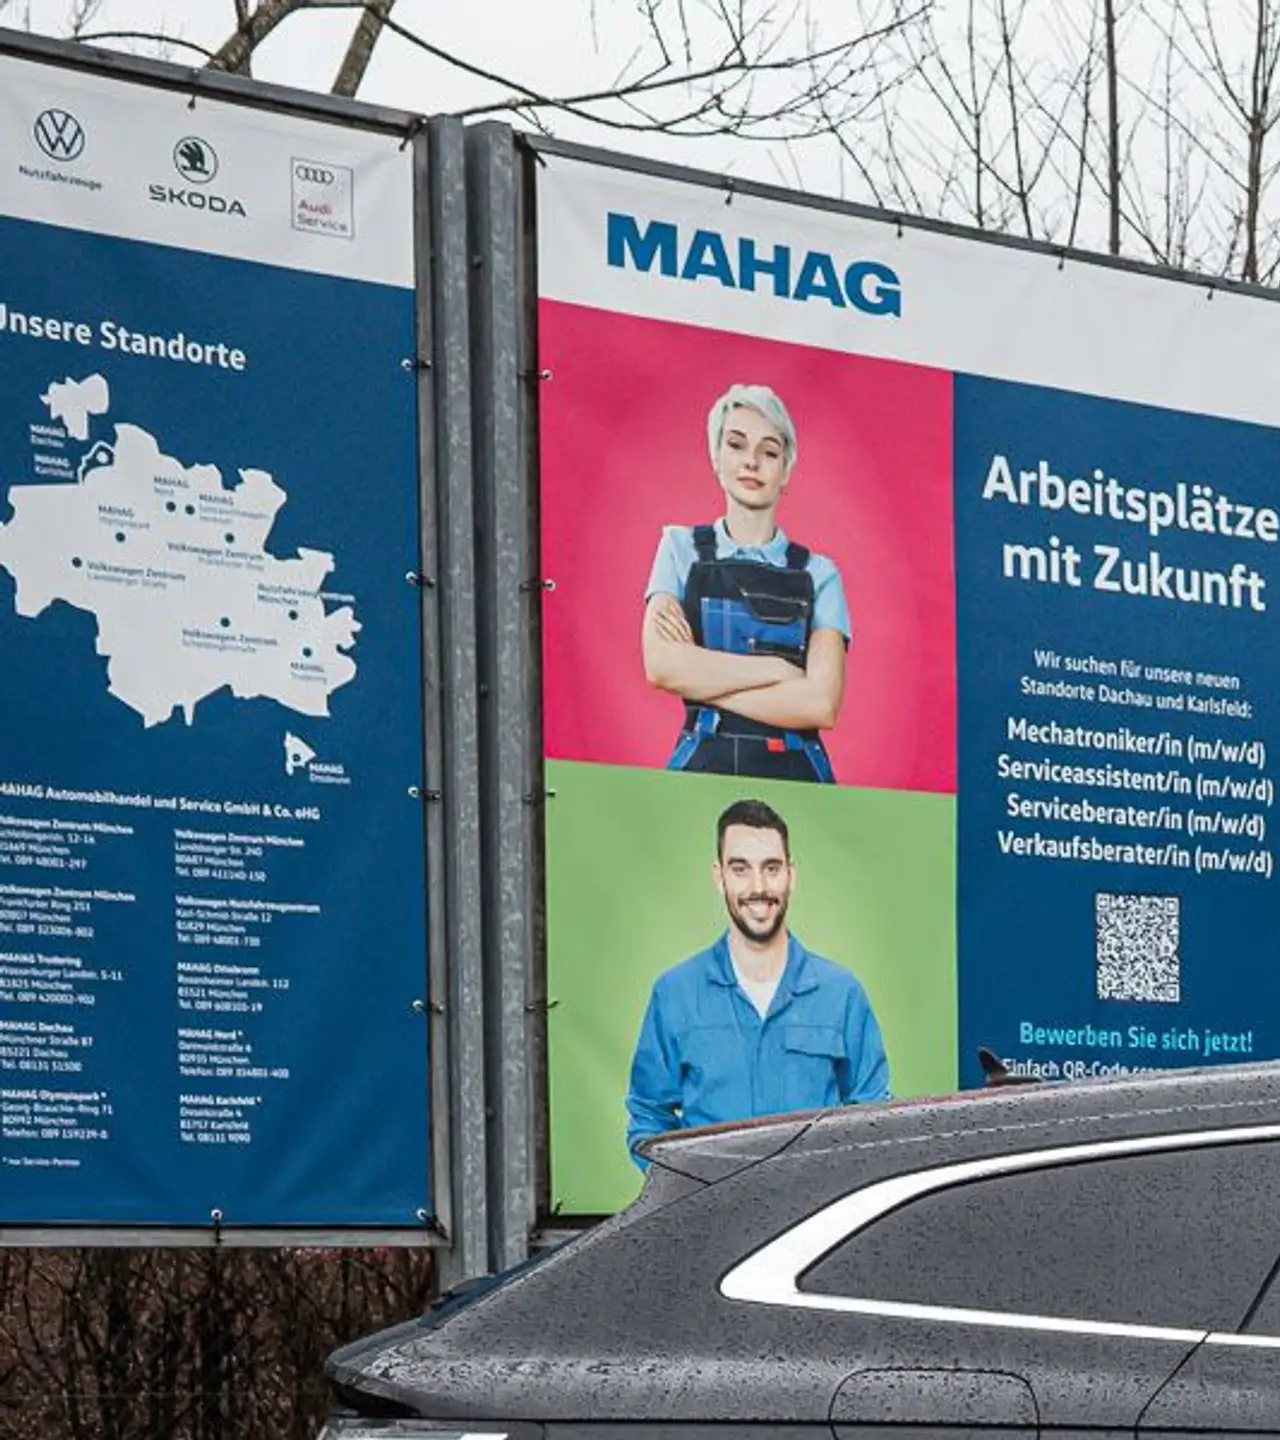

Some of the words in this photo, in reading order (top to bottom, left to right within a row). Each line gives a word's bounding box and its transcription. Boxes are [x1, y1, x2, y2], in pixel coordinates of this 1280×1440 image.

[607, 211, 901, 318] MAHAG
[100, 321, 247, 371] Standorte
[982, 454, 1280, 542] Arbeitsplätze
[1003, 535, 1082, 588] mit
[1093, 544, 1266, 612] Zukunft
[1033, 648, 1060, 669] Wir
[1065, 656, 1117, 676] suchen
[1120, 659, 1140, 678] für
[1145, 665, 1192, 686] unsere
[1195, 672, 1240, 690] neuen
[1020, 675, 1095, 700] Standorte
[1099, 684, 1152, 708] Dachau
[1156, 693, 1184, 711] und
[1187, 695, 1252, 719] Karlsfeld:
[1007, 717, 1183, 758] Mechatroniker/in
[1187, 734, 1265, 770] (m/w/d)
[46, 787, 152, 807] Automobilhandel
[154, 797, 176, 810] und
[180, 797, 222, 812] Service
[224, 801, 260, 816] GmbH
[998, 754, 1192, 795] Serviceassistent/in
[1196, 773, 1274, 808] (m/w/d)
[1007, 793, 1183, 831] Serviceberater/in
[1187, 808, 1265, 842] (m/w/d)
[998, 830, 1191, 868] Verkaufsberater/in
[1195, 845, 1274, 879] (m/w/d)
[1019, 1022, 1122, 1048] Bewerben
[1128, 1026, 1157, 1049] Sie
[1161, 1028, 1200, 1051] sich
[1202, 1030, 1253, 1057] jetzt!
[1002, 1058, 1060, 1078] Einfach
